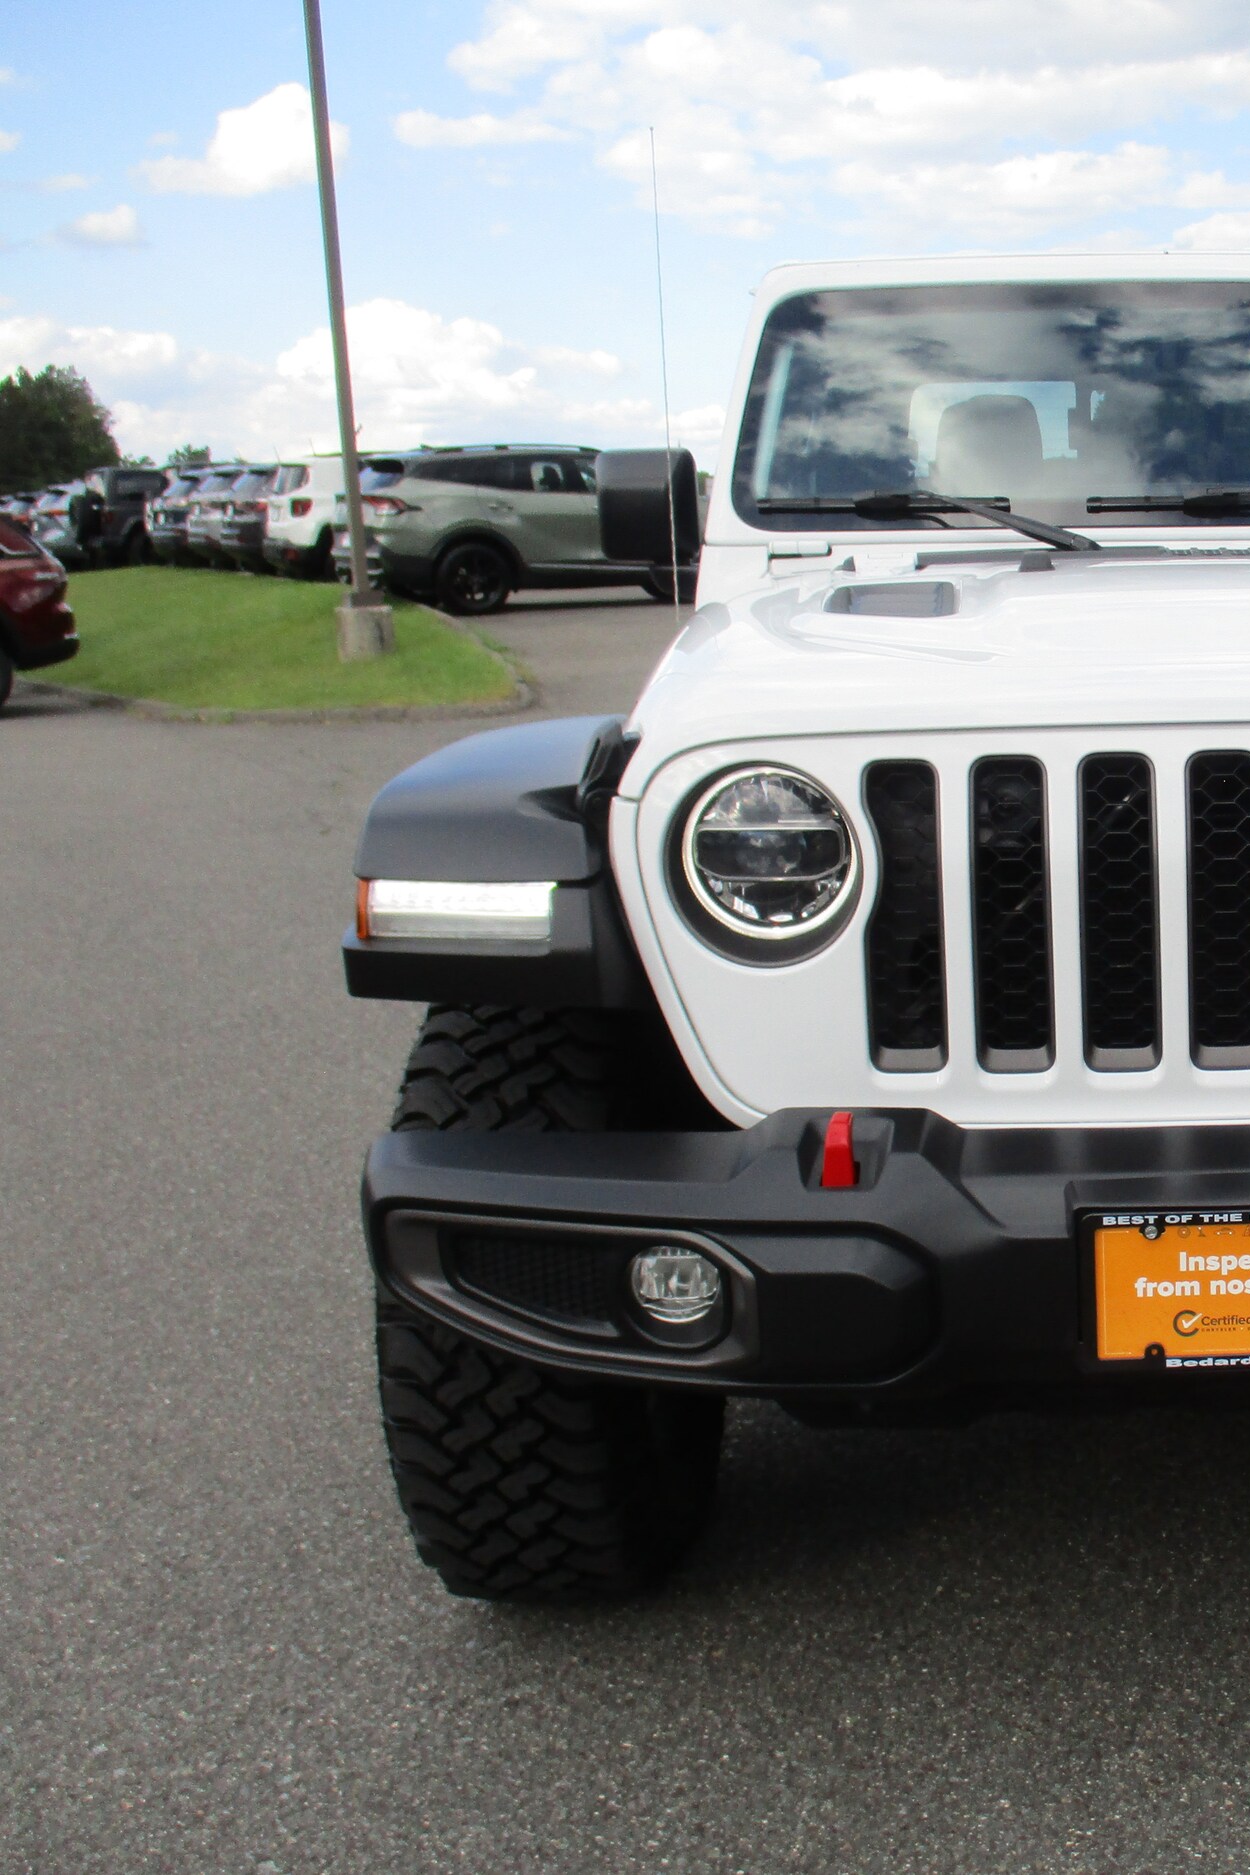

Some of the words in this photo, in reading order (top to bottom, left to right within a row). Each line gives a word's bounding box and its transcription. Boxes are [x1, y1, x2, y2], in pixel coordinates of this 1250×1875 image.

[1102, 1215, 1158, 1225] BEST
[1165, 1214, 1193, 1224] OF
[1199, 1212, 1243, 1223] THE
[1134, 1277, 1201, 1298] from
